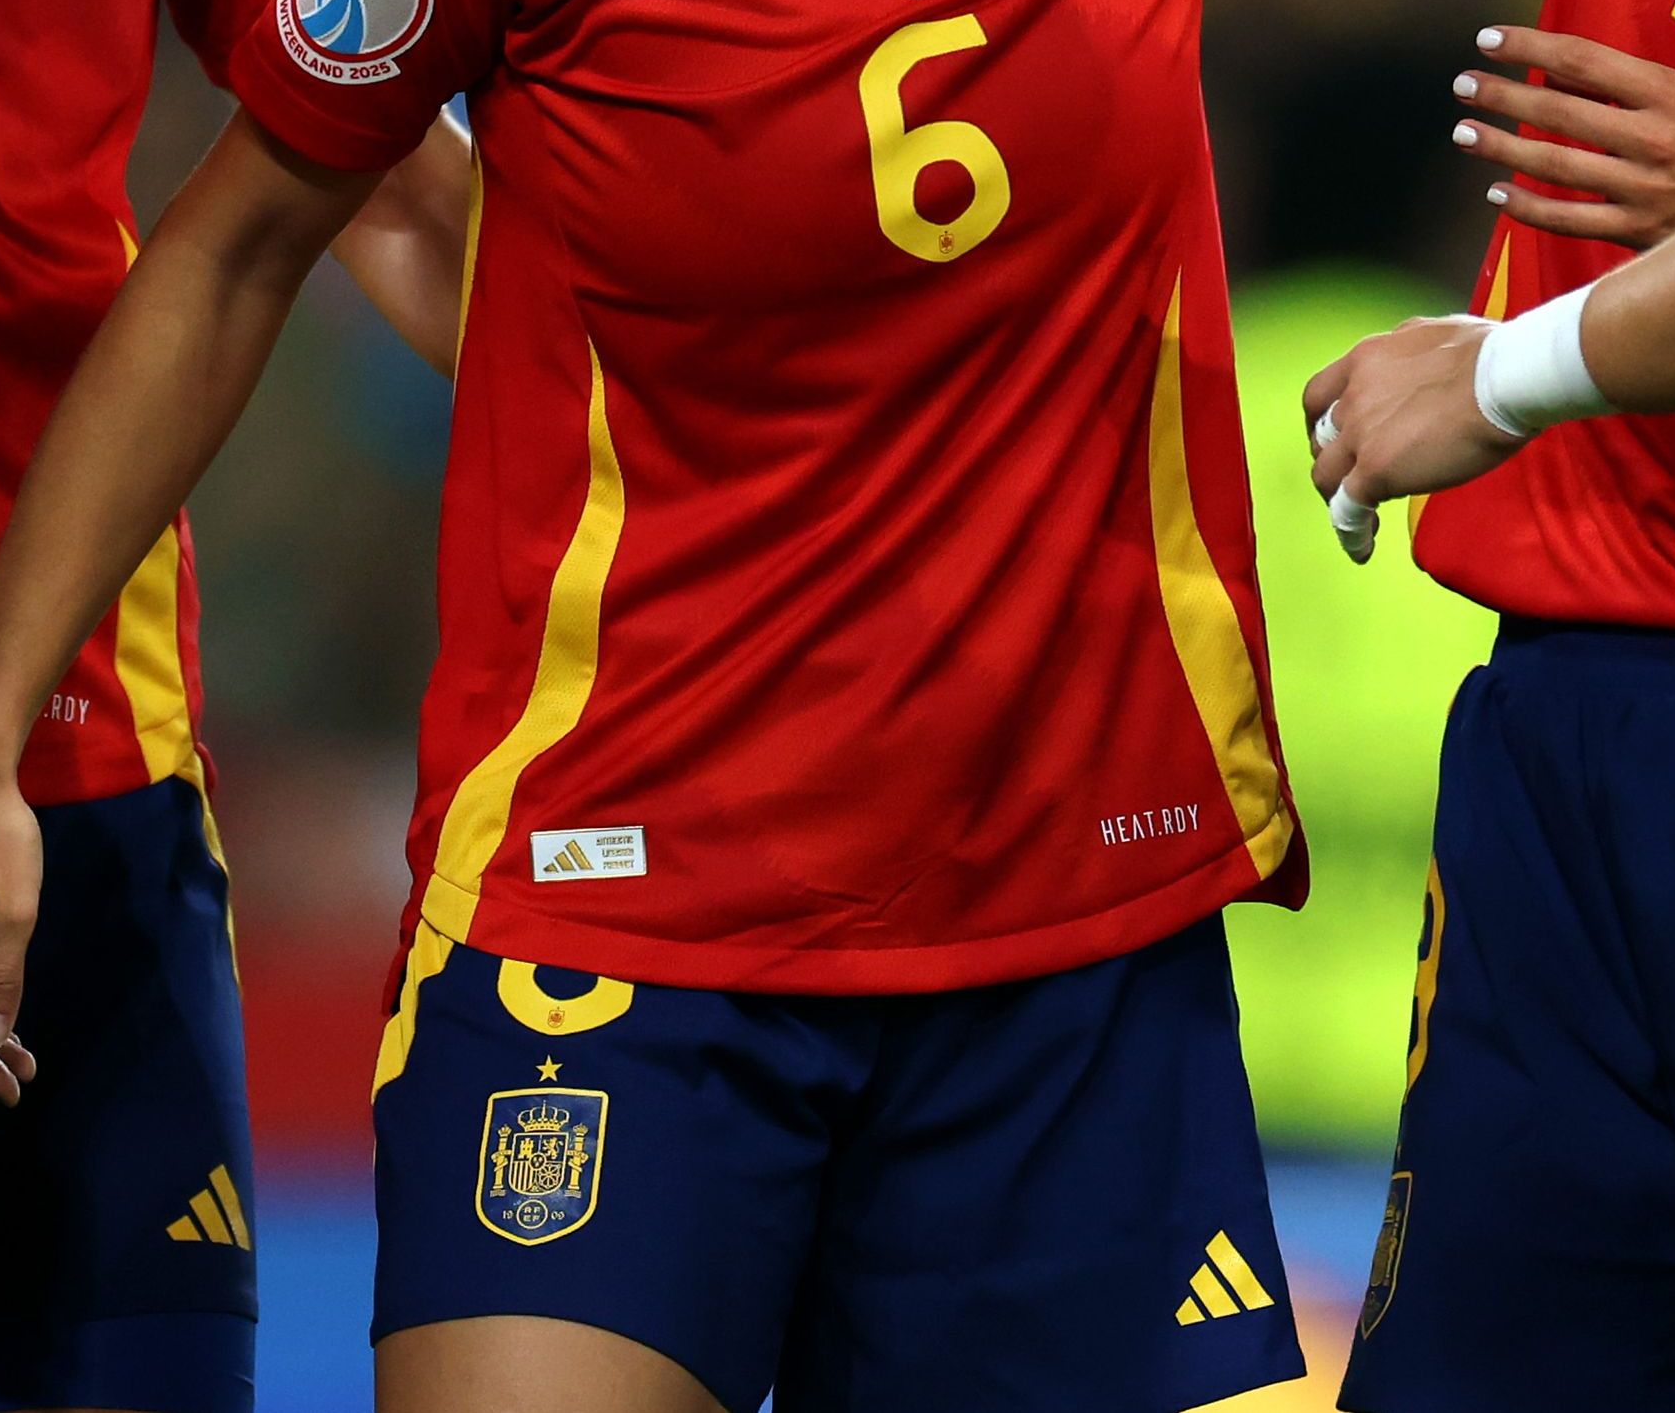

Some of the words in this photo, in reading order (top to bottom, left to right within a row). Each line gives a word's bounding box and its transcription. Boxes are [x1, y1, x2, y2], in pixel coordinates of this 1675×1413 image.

[350, 62, 391, 79] 2025
[859, 13, 1011, 263] 6
[43, 694, 90, 725] .RDY
[1100, 804, 1198, 846] HEAT.RDY
